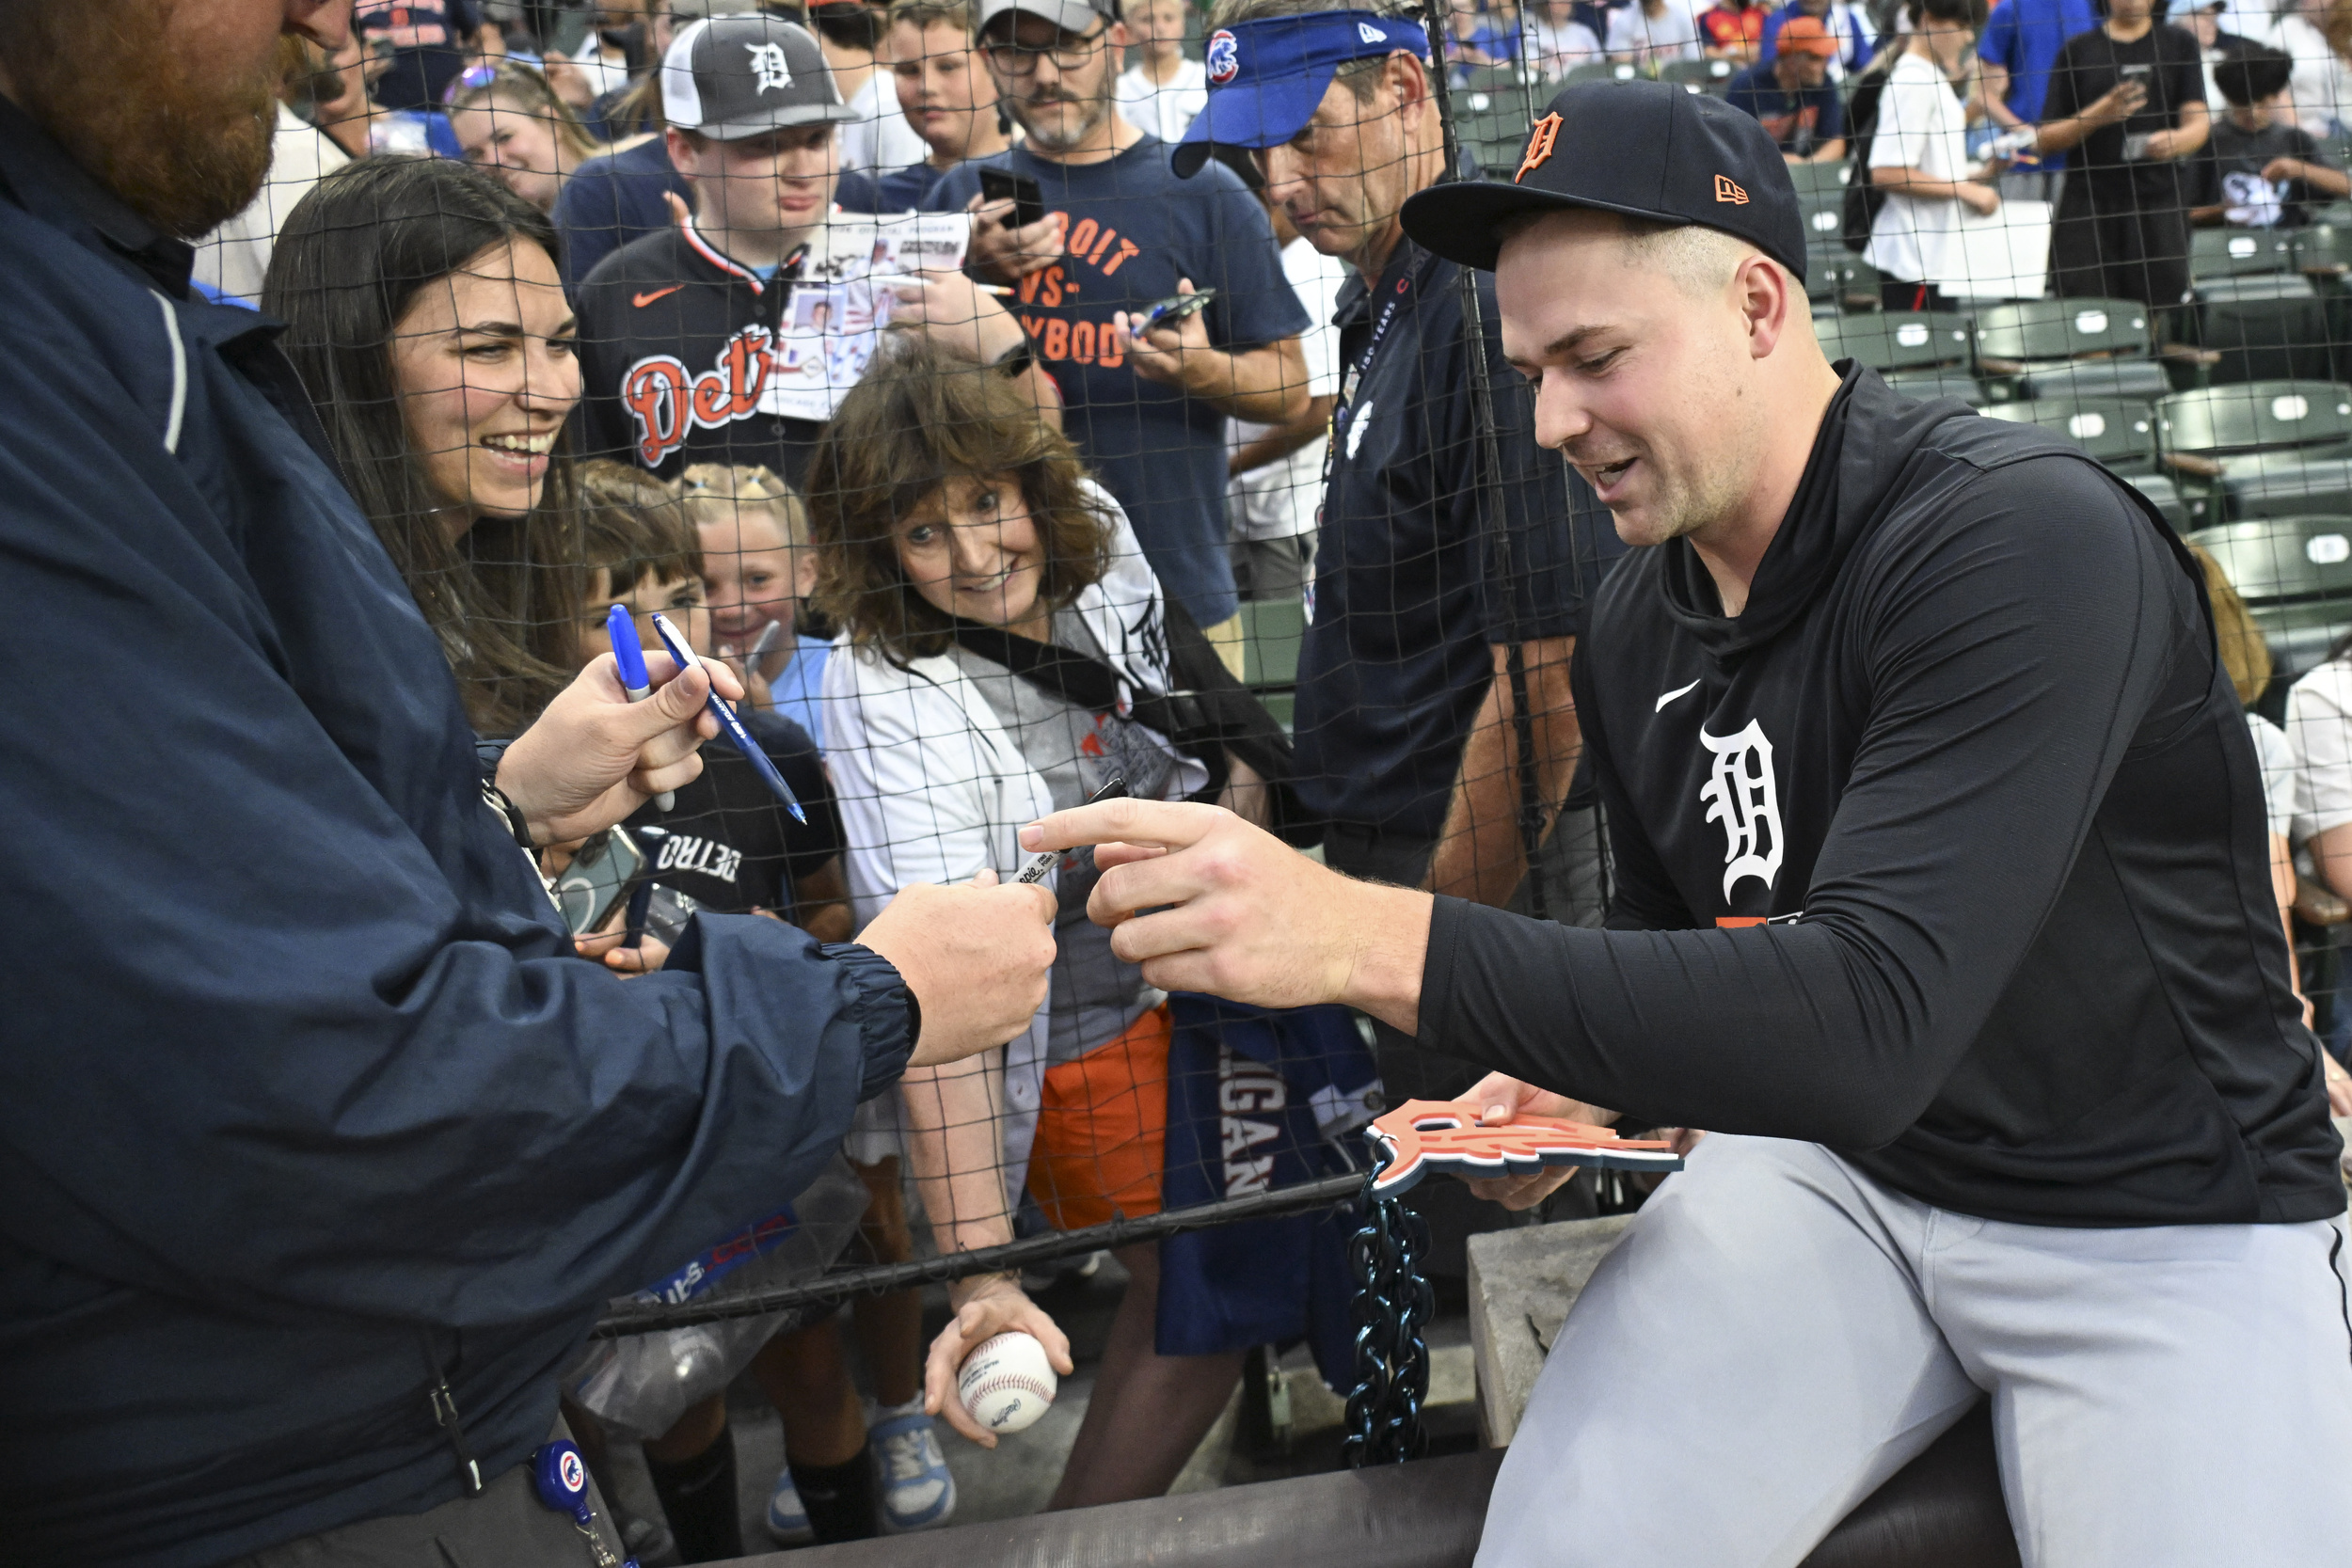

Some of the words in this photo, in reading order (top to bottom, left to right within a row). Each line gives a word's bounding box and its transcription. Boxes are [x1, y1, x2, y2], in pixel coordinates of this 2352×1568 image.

[1515, 111, 1564, 184] D
[1699, 718, 1785, 907] D
[1038, 853, 1047, 863] FINE
[1041, 854, 1054, 867] POINT
